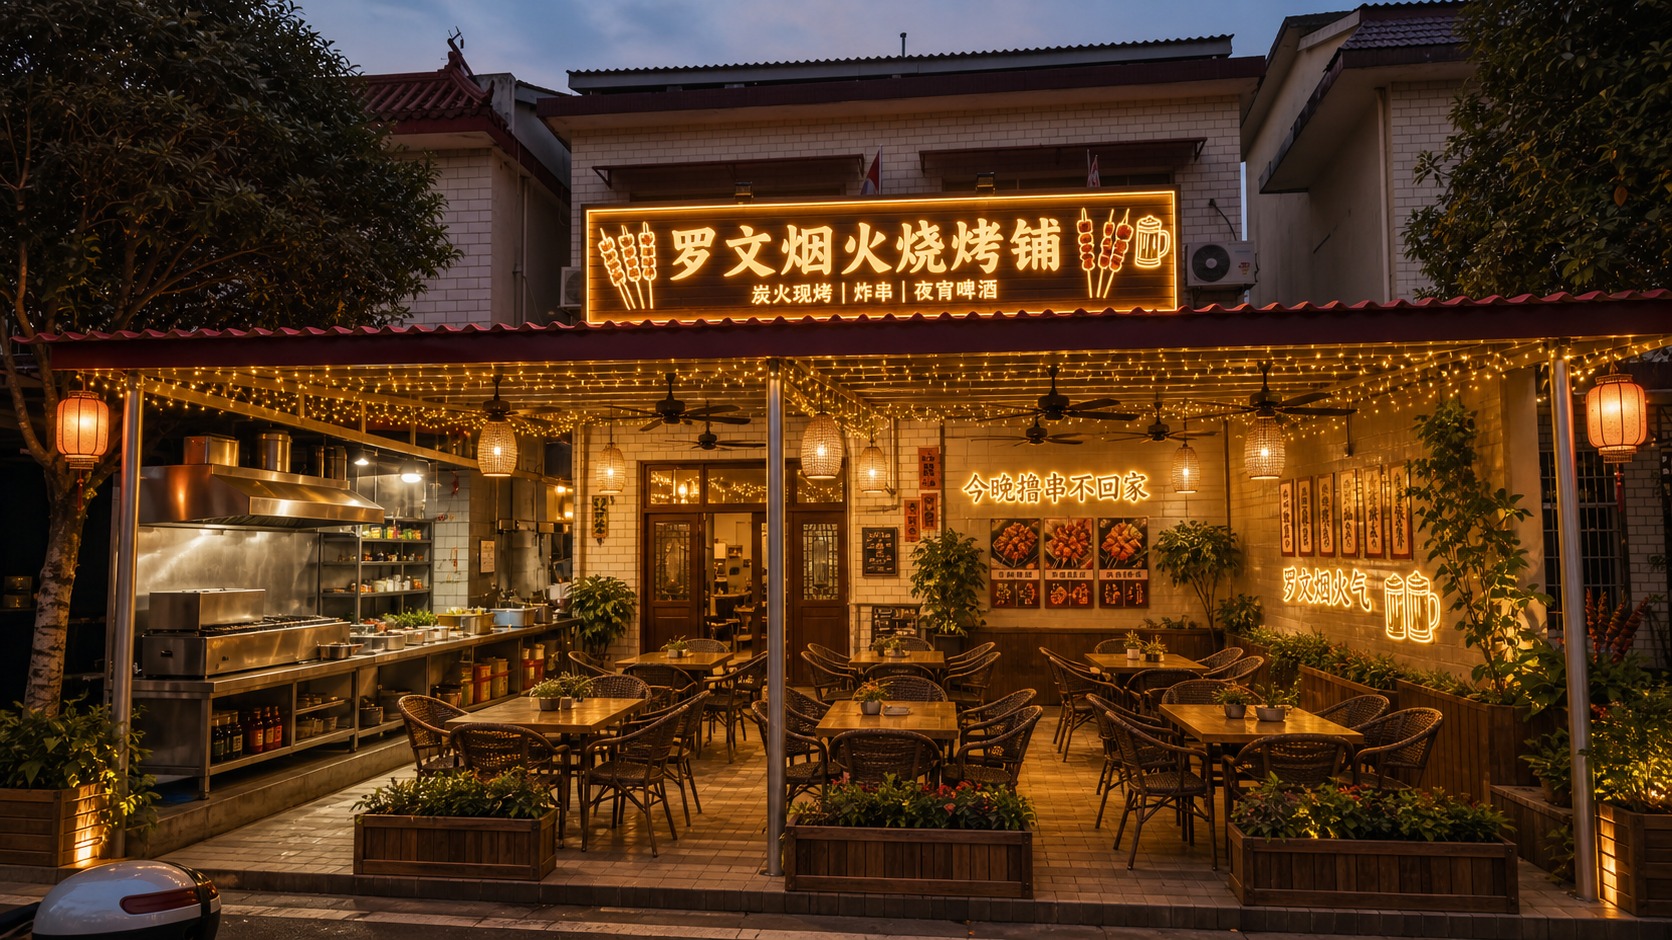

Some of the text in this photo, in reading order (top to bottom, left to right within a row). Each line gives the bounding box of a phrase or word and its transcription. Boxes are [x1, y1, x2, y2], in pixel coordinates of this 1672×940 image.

[671, 219, 1060, 280] 罗文烟火烧烤铺
[752, 283, 832, 304] 炭火现烤
[854, 281, 893, 302] 炸串
[962, 471, 1150, 504] 今晚撸串不回家
[1282, 566, 1372, 612] 罗文烟火气
